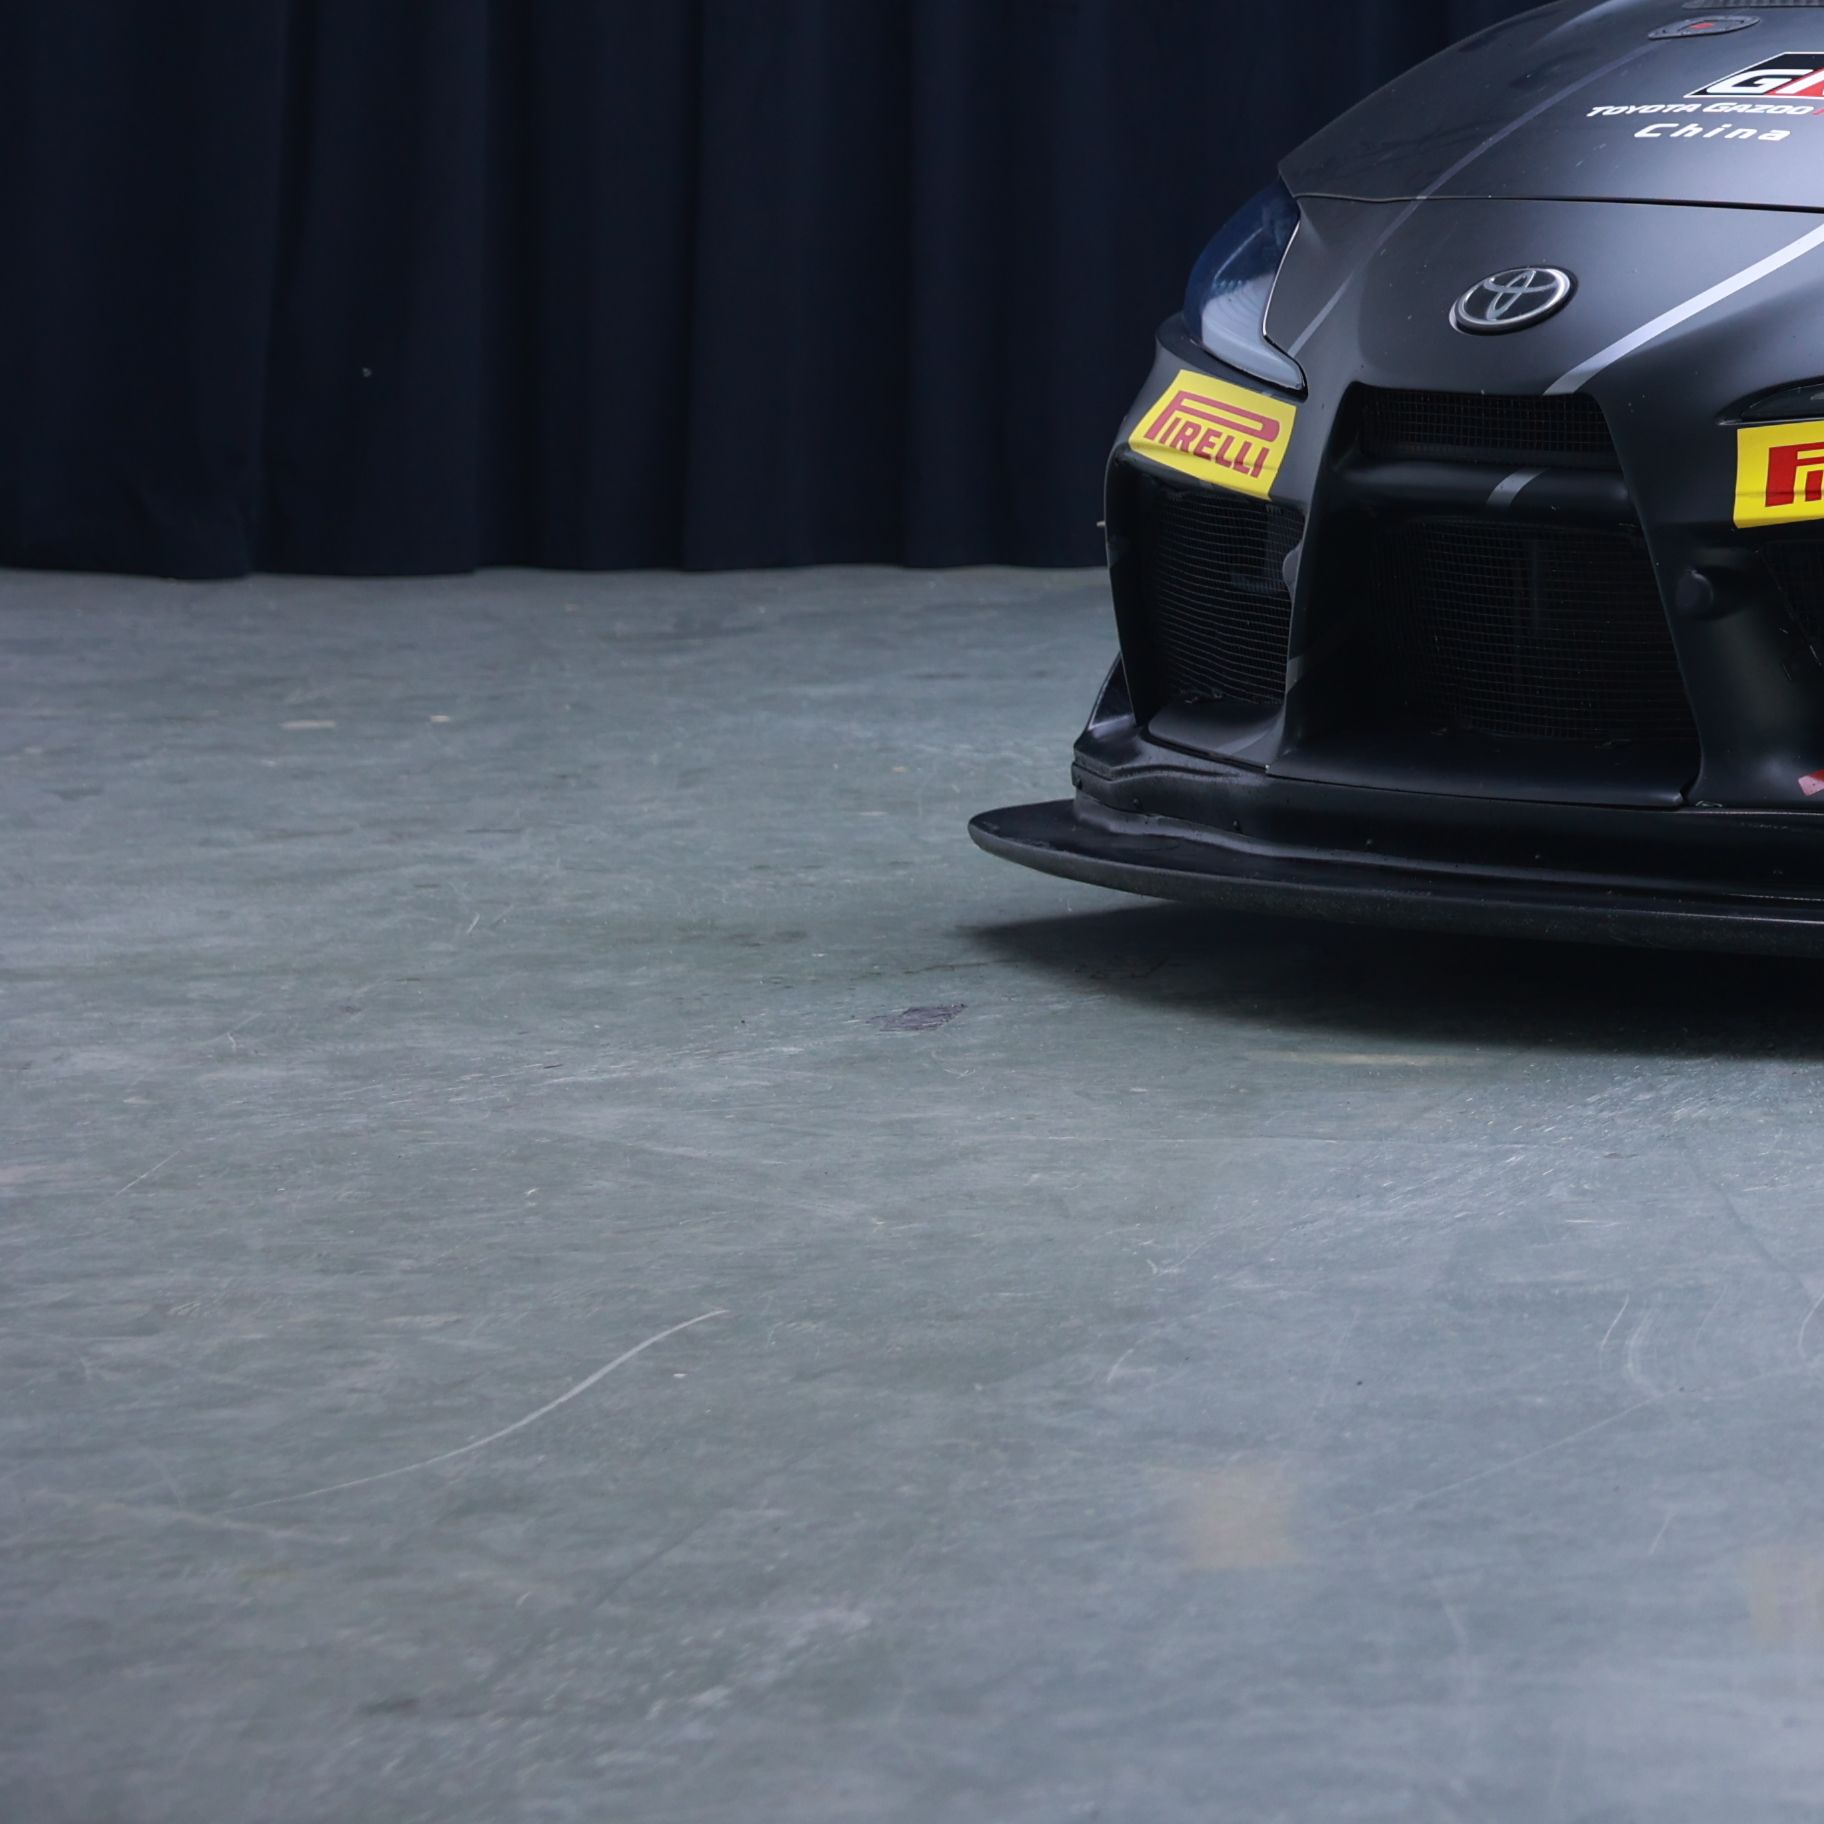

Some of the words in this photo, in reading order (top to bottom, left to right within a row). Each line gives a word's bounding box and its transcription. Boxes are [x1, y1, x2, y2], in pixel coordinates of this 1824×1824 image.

[1586, 103, 1702, 117] TOYOTA
[1703, 102, 1814, 116] GAZOO
[1633, 122, 1793, 142] China
[1144, 389, 1281, 479] PIRELLI
